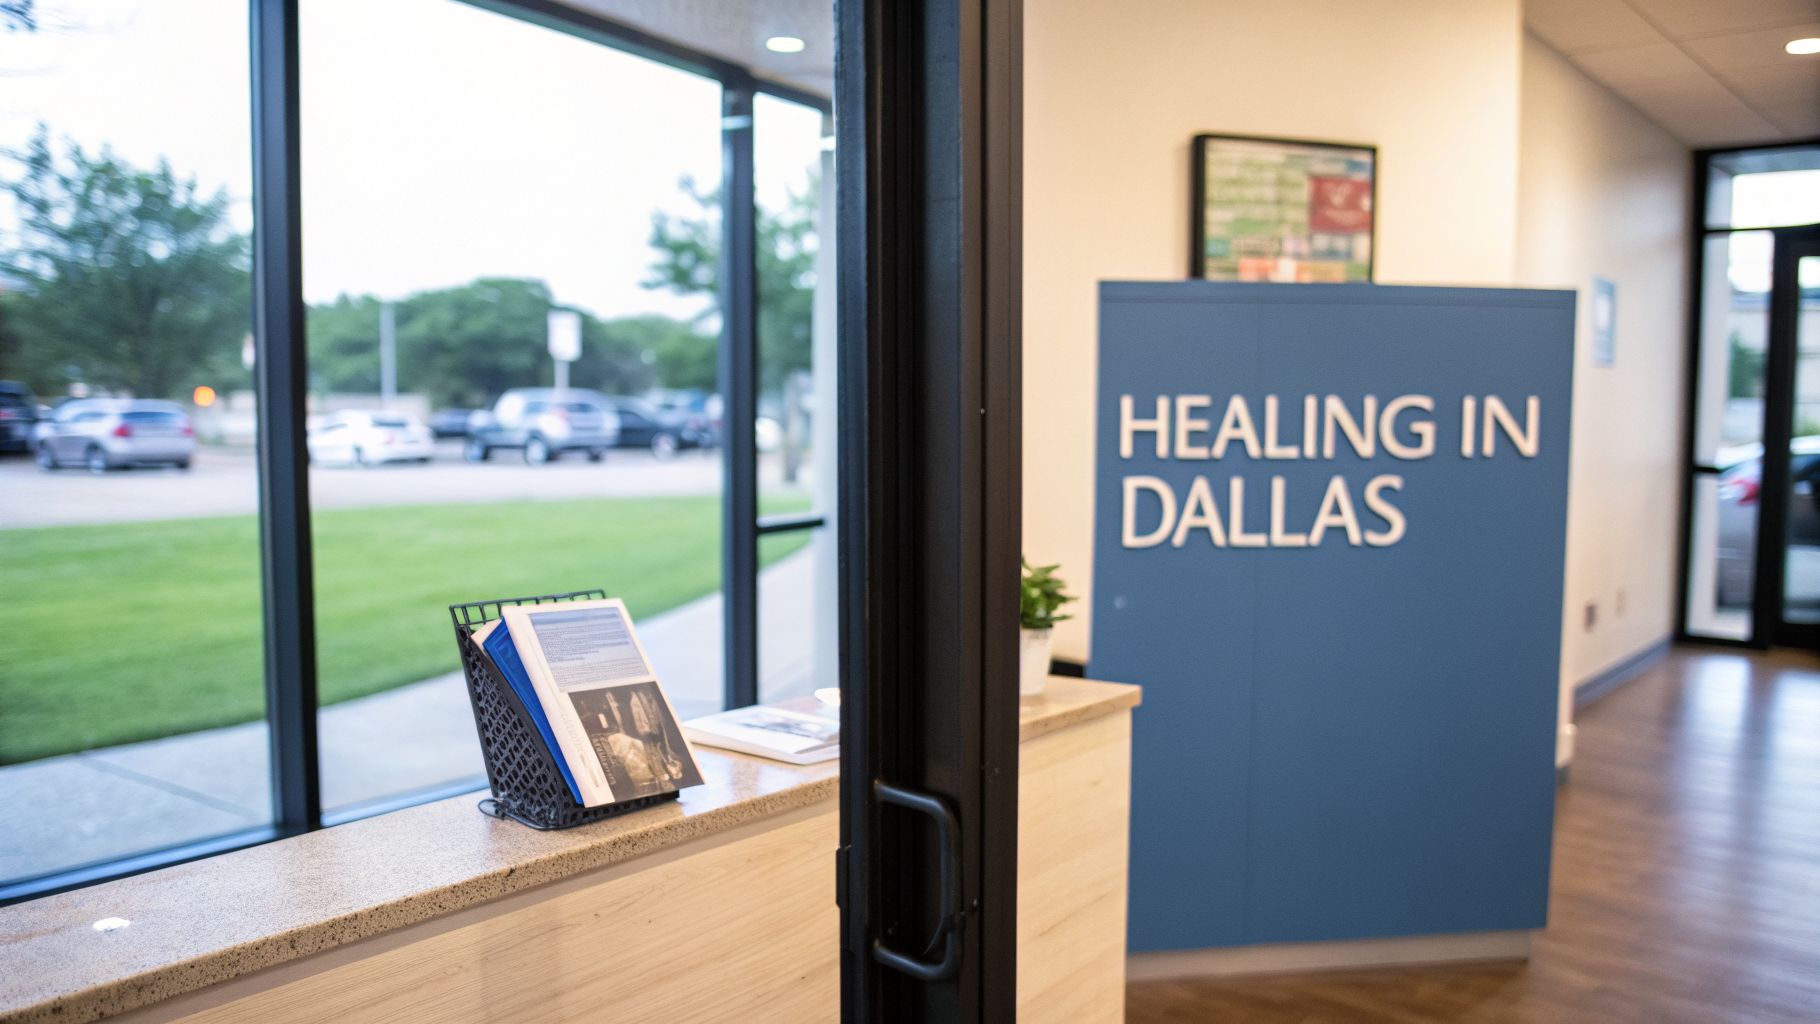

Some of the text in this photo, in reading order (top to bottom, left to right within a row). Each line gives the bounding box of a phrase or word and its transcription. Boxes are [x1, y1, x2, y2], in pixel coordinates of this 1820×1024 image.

[1119, 394, 1541, 460] HEALING IN
[1121, 474, 1407, 548] DALLAS
